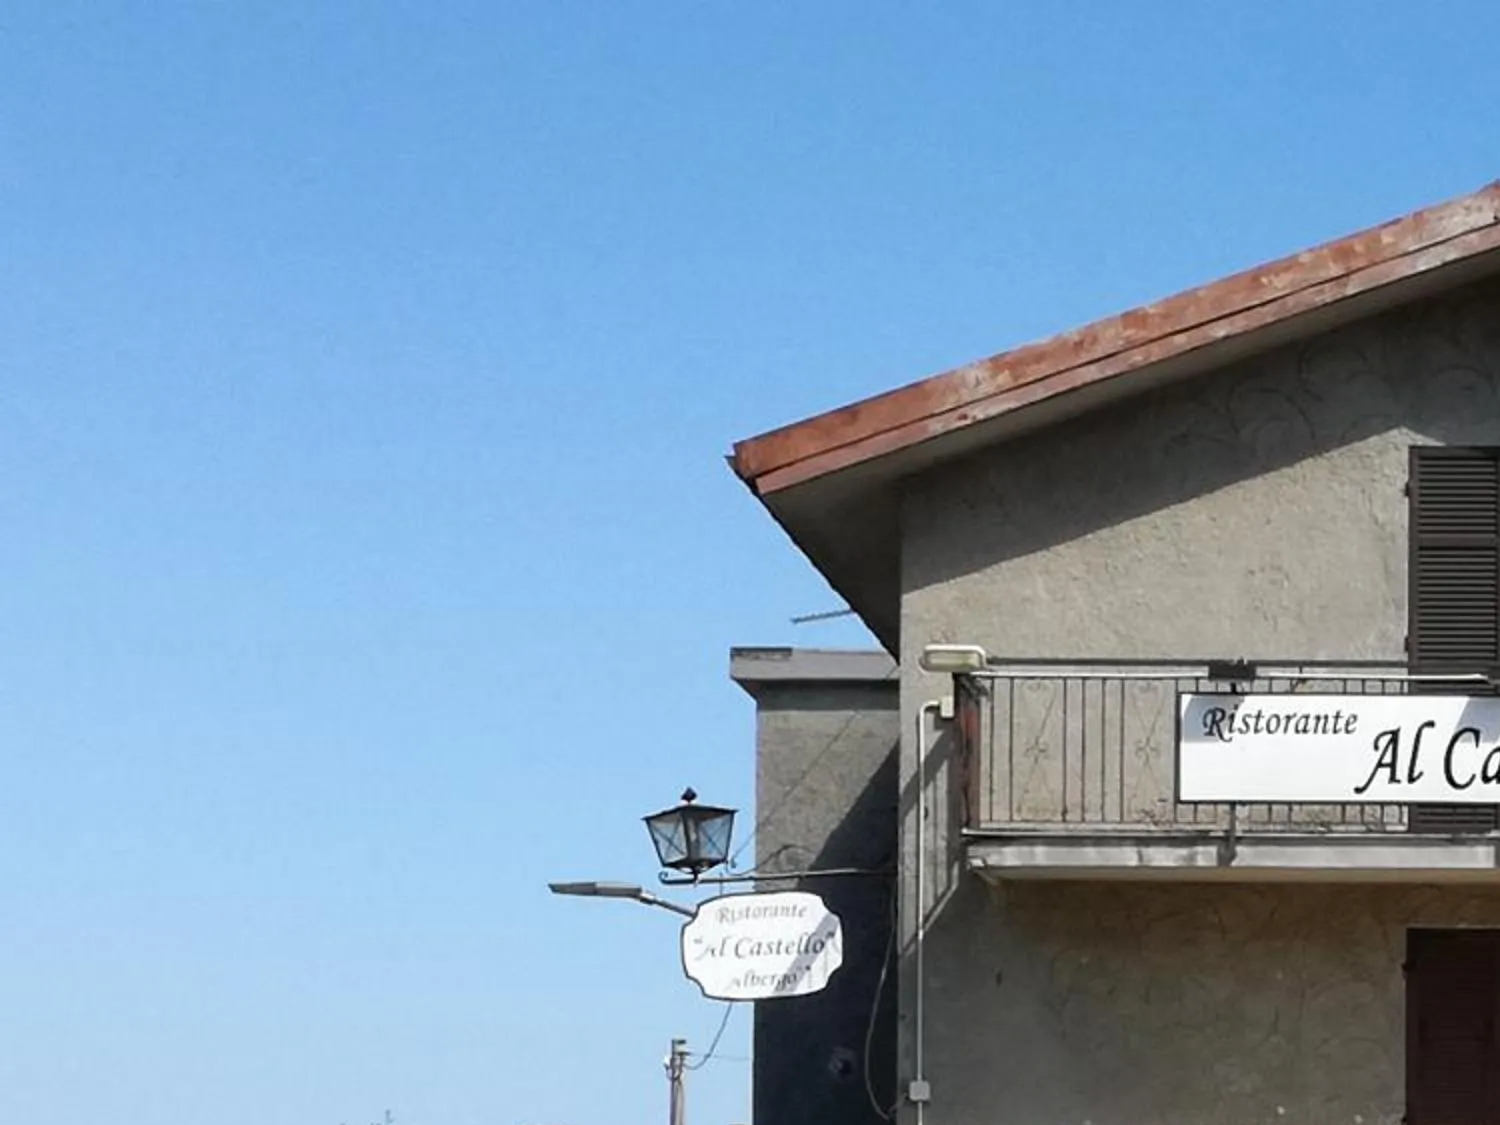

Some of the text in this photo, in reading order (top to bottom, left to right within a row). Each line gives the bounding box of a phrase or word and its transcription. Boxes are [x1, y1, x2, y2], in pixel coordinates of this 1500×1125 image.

[1202, 705, 1358, 742] Ristorante
[1353, 720, 1437, 796] Al
[716, 904, 807, 924] Ristorante
[724, 969, 798, 992] Albergo
